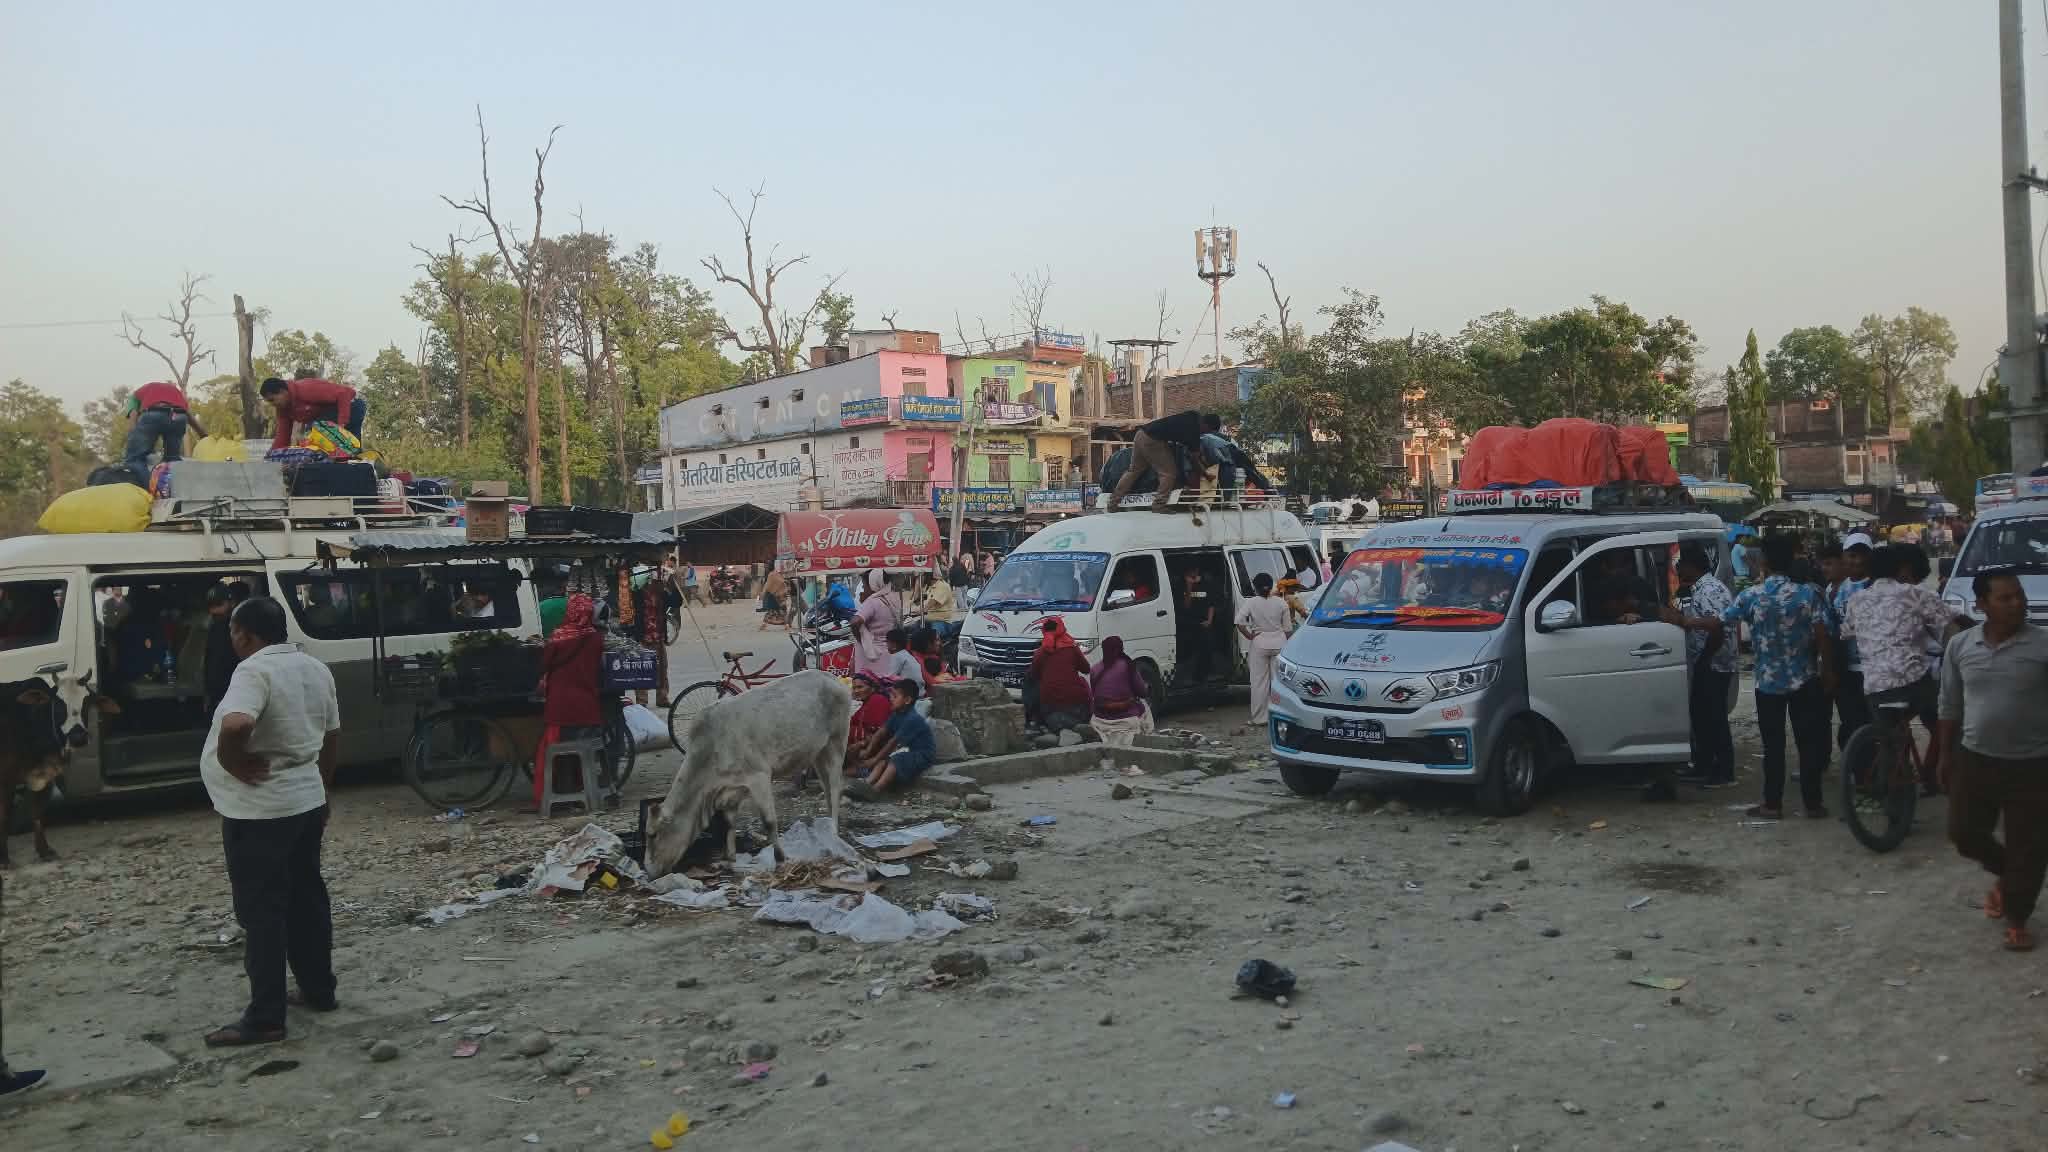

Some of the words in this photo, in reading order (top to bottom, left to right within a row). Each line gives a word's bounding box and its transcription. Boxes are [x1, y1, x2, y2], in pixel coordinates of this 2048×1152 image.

[680, 462, 723, 488] अतरिया
[1511, 490, 1532, 508] To
[815, 527, 880, 550] Milky
